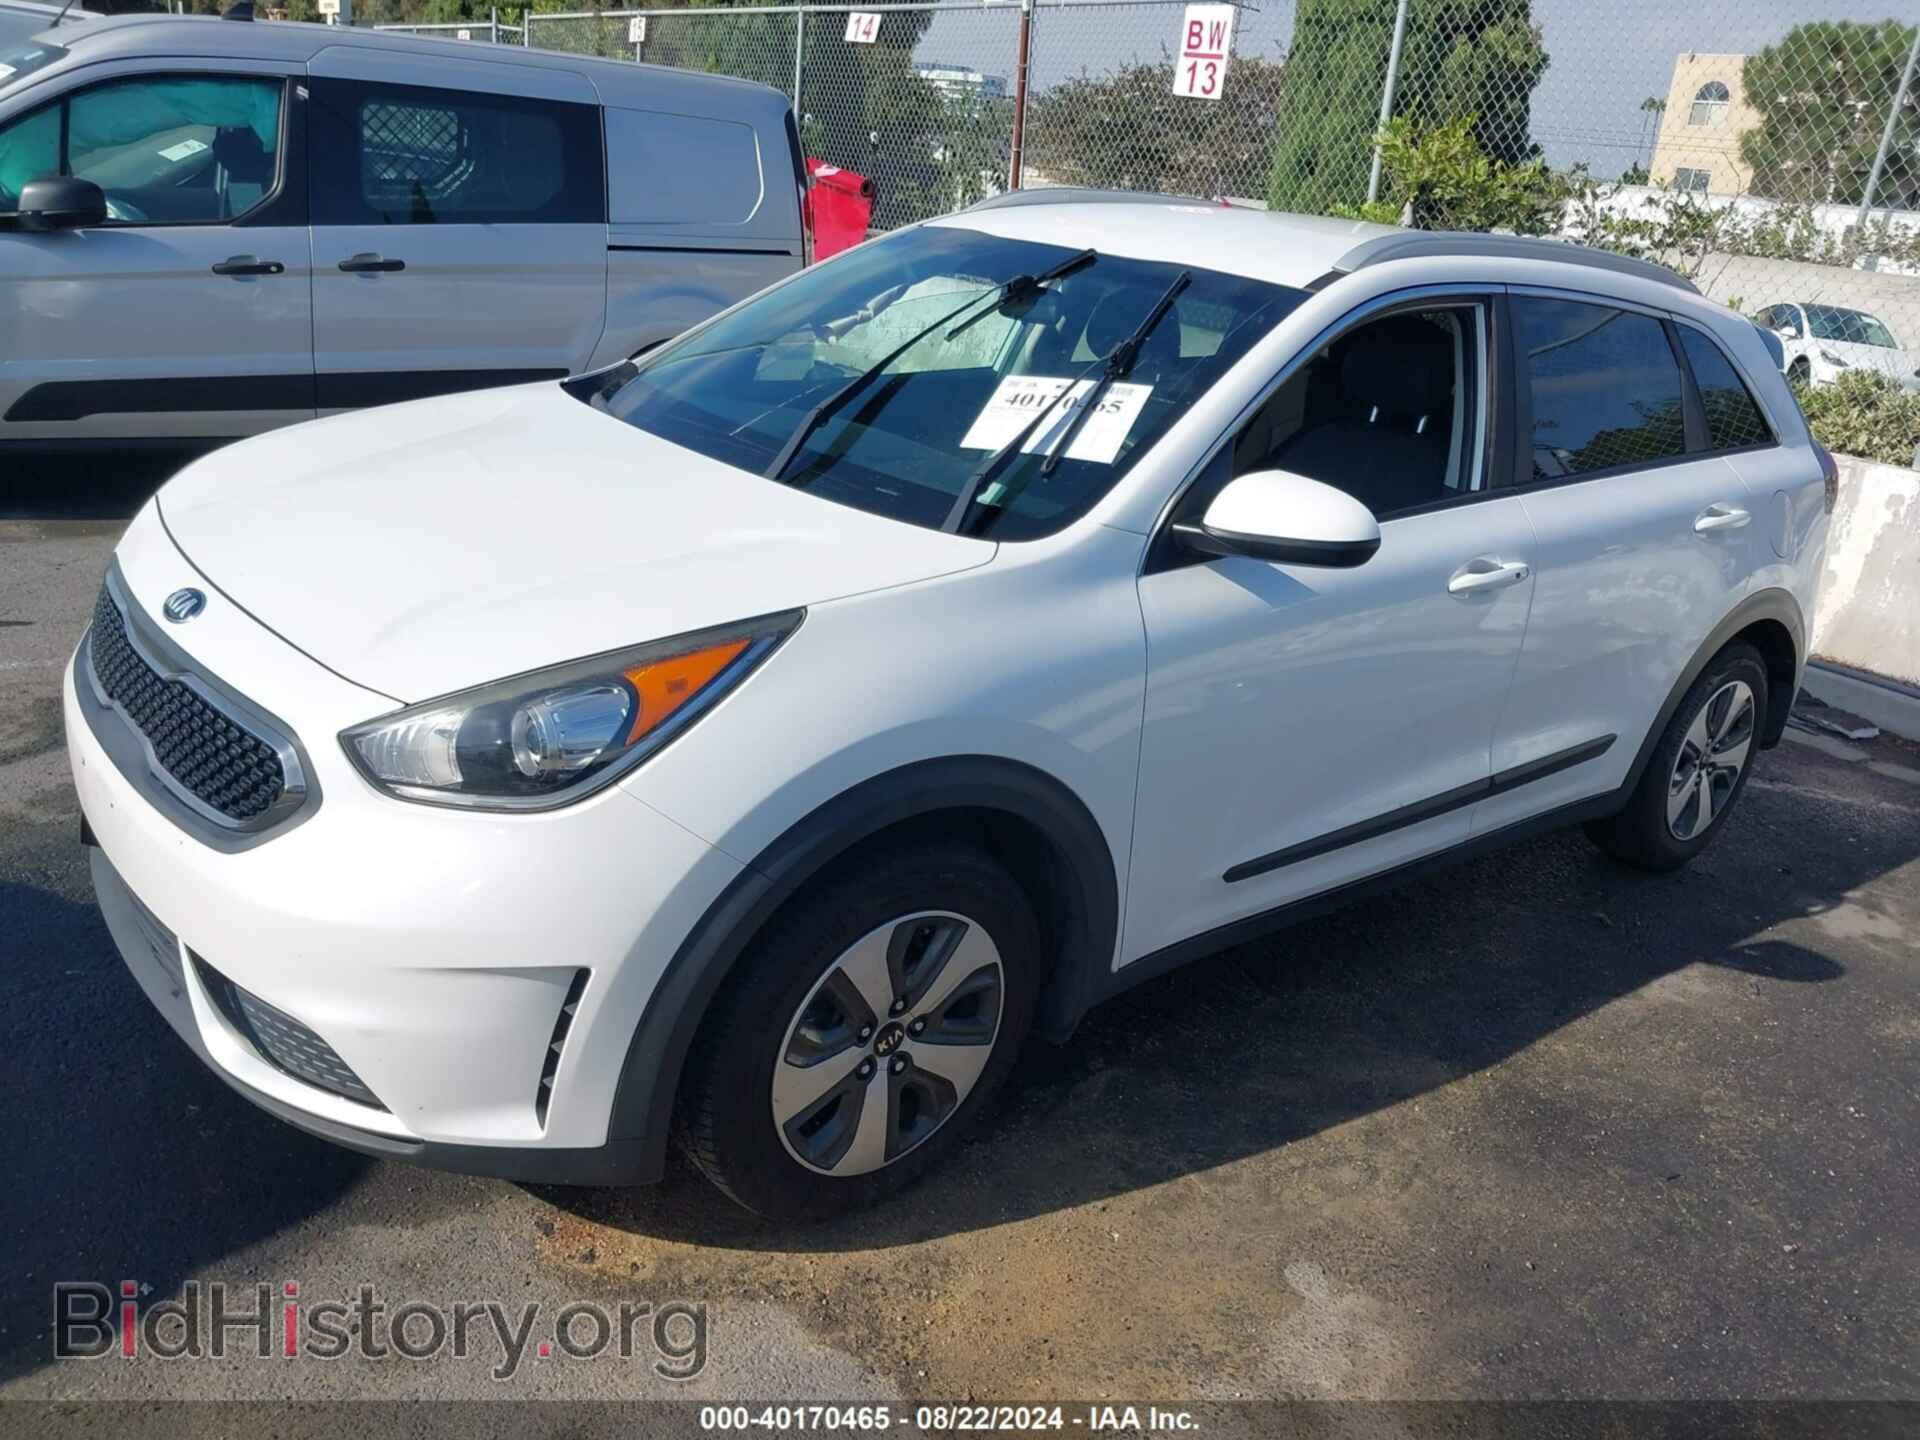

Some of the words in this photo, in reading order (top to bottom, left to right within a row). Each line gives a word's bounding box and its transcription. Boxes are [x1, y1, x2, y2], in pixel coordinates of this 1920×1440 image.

[854, 15, 875, 40] 14
[1187, 20, 1227, 50] BW
[1186, 60, 1217, 95] 13
[878, 1030, 903, 1052] KIA
